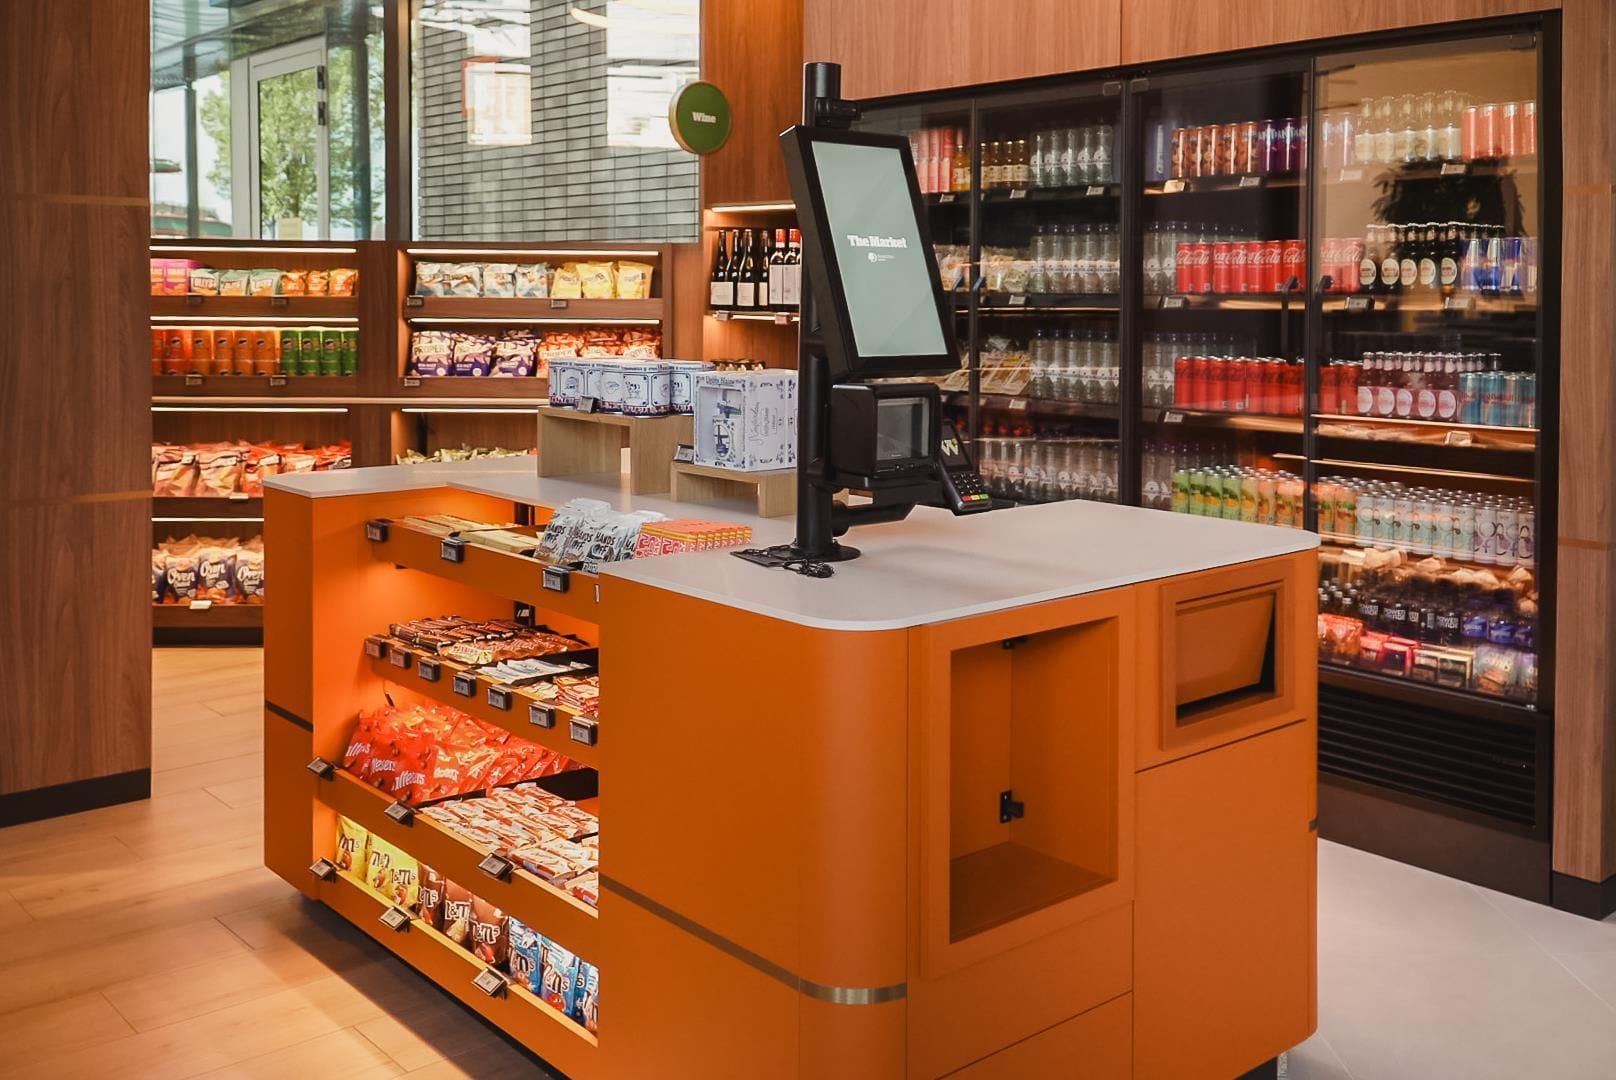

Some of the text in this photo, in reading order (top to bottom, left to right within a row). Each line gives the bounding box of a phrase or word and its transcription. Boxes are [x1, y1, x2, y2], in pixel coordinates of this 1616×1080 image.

[692, 111, 717, 124] Wine
[847, 235, 908, 248] The Market
[167, 567, 196, 585] Oven
[200, 560, 227, 577] Oven
